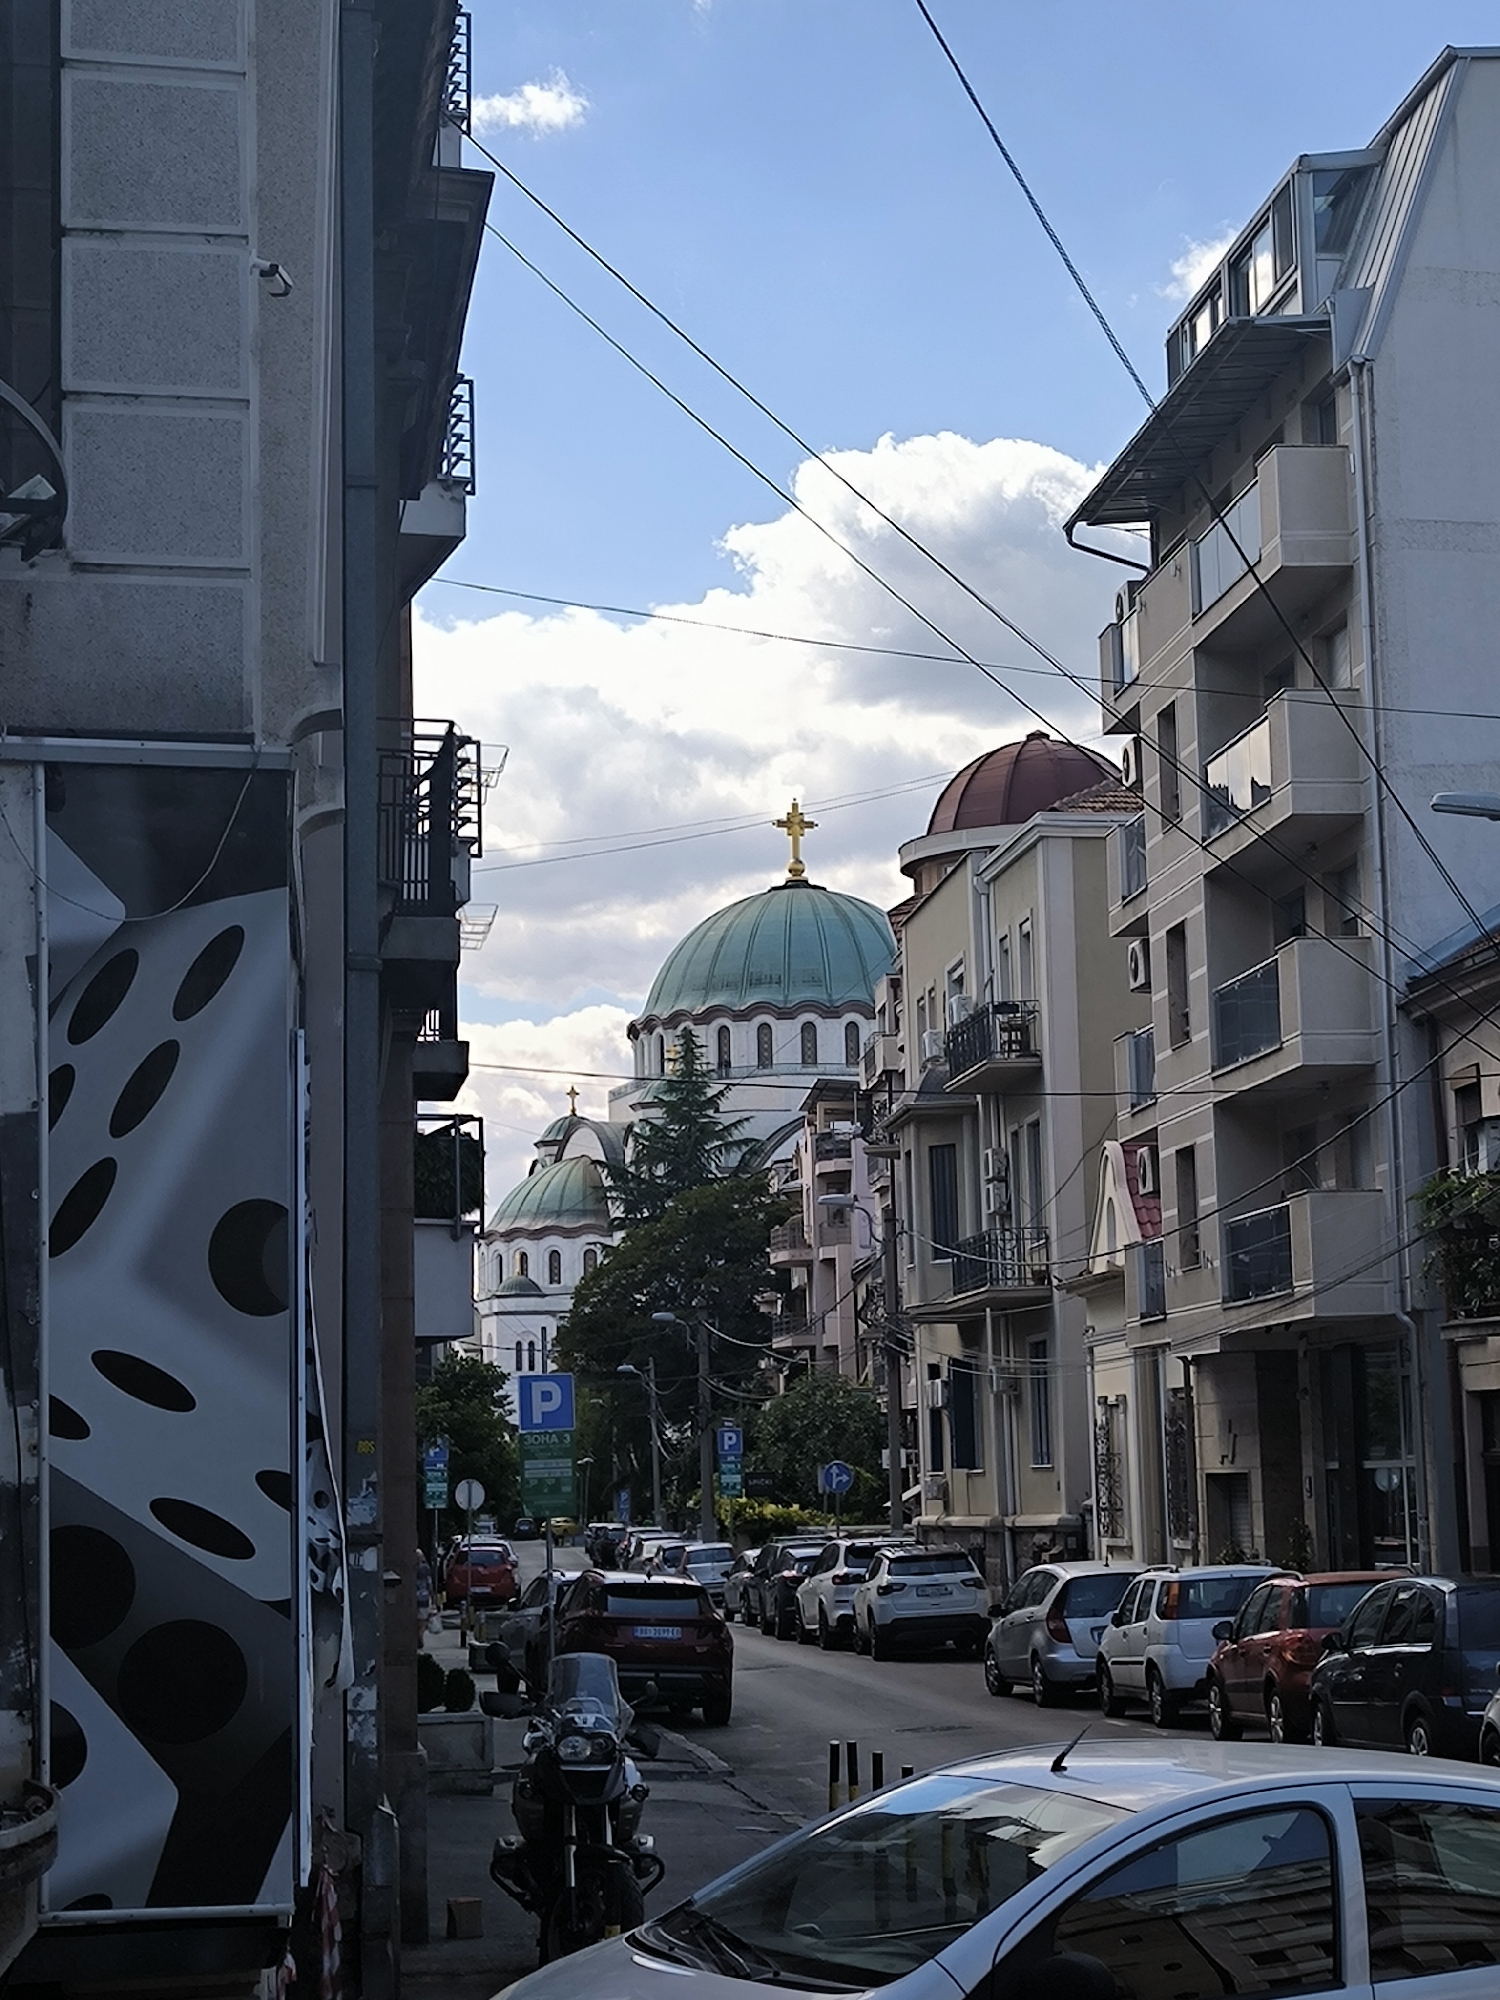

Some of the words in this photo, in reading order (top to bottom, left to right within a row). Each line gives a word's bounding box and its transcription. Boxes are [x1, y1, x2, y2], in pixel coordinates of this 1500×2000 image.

[531, 1381, 562, 1424] P
[523, 1434, 559, 1445] ЗОНА
[563, 1434, 571, 1444] 3
[723, 1432, 737, 1450] P
